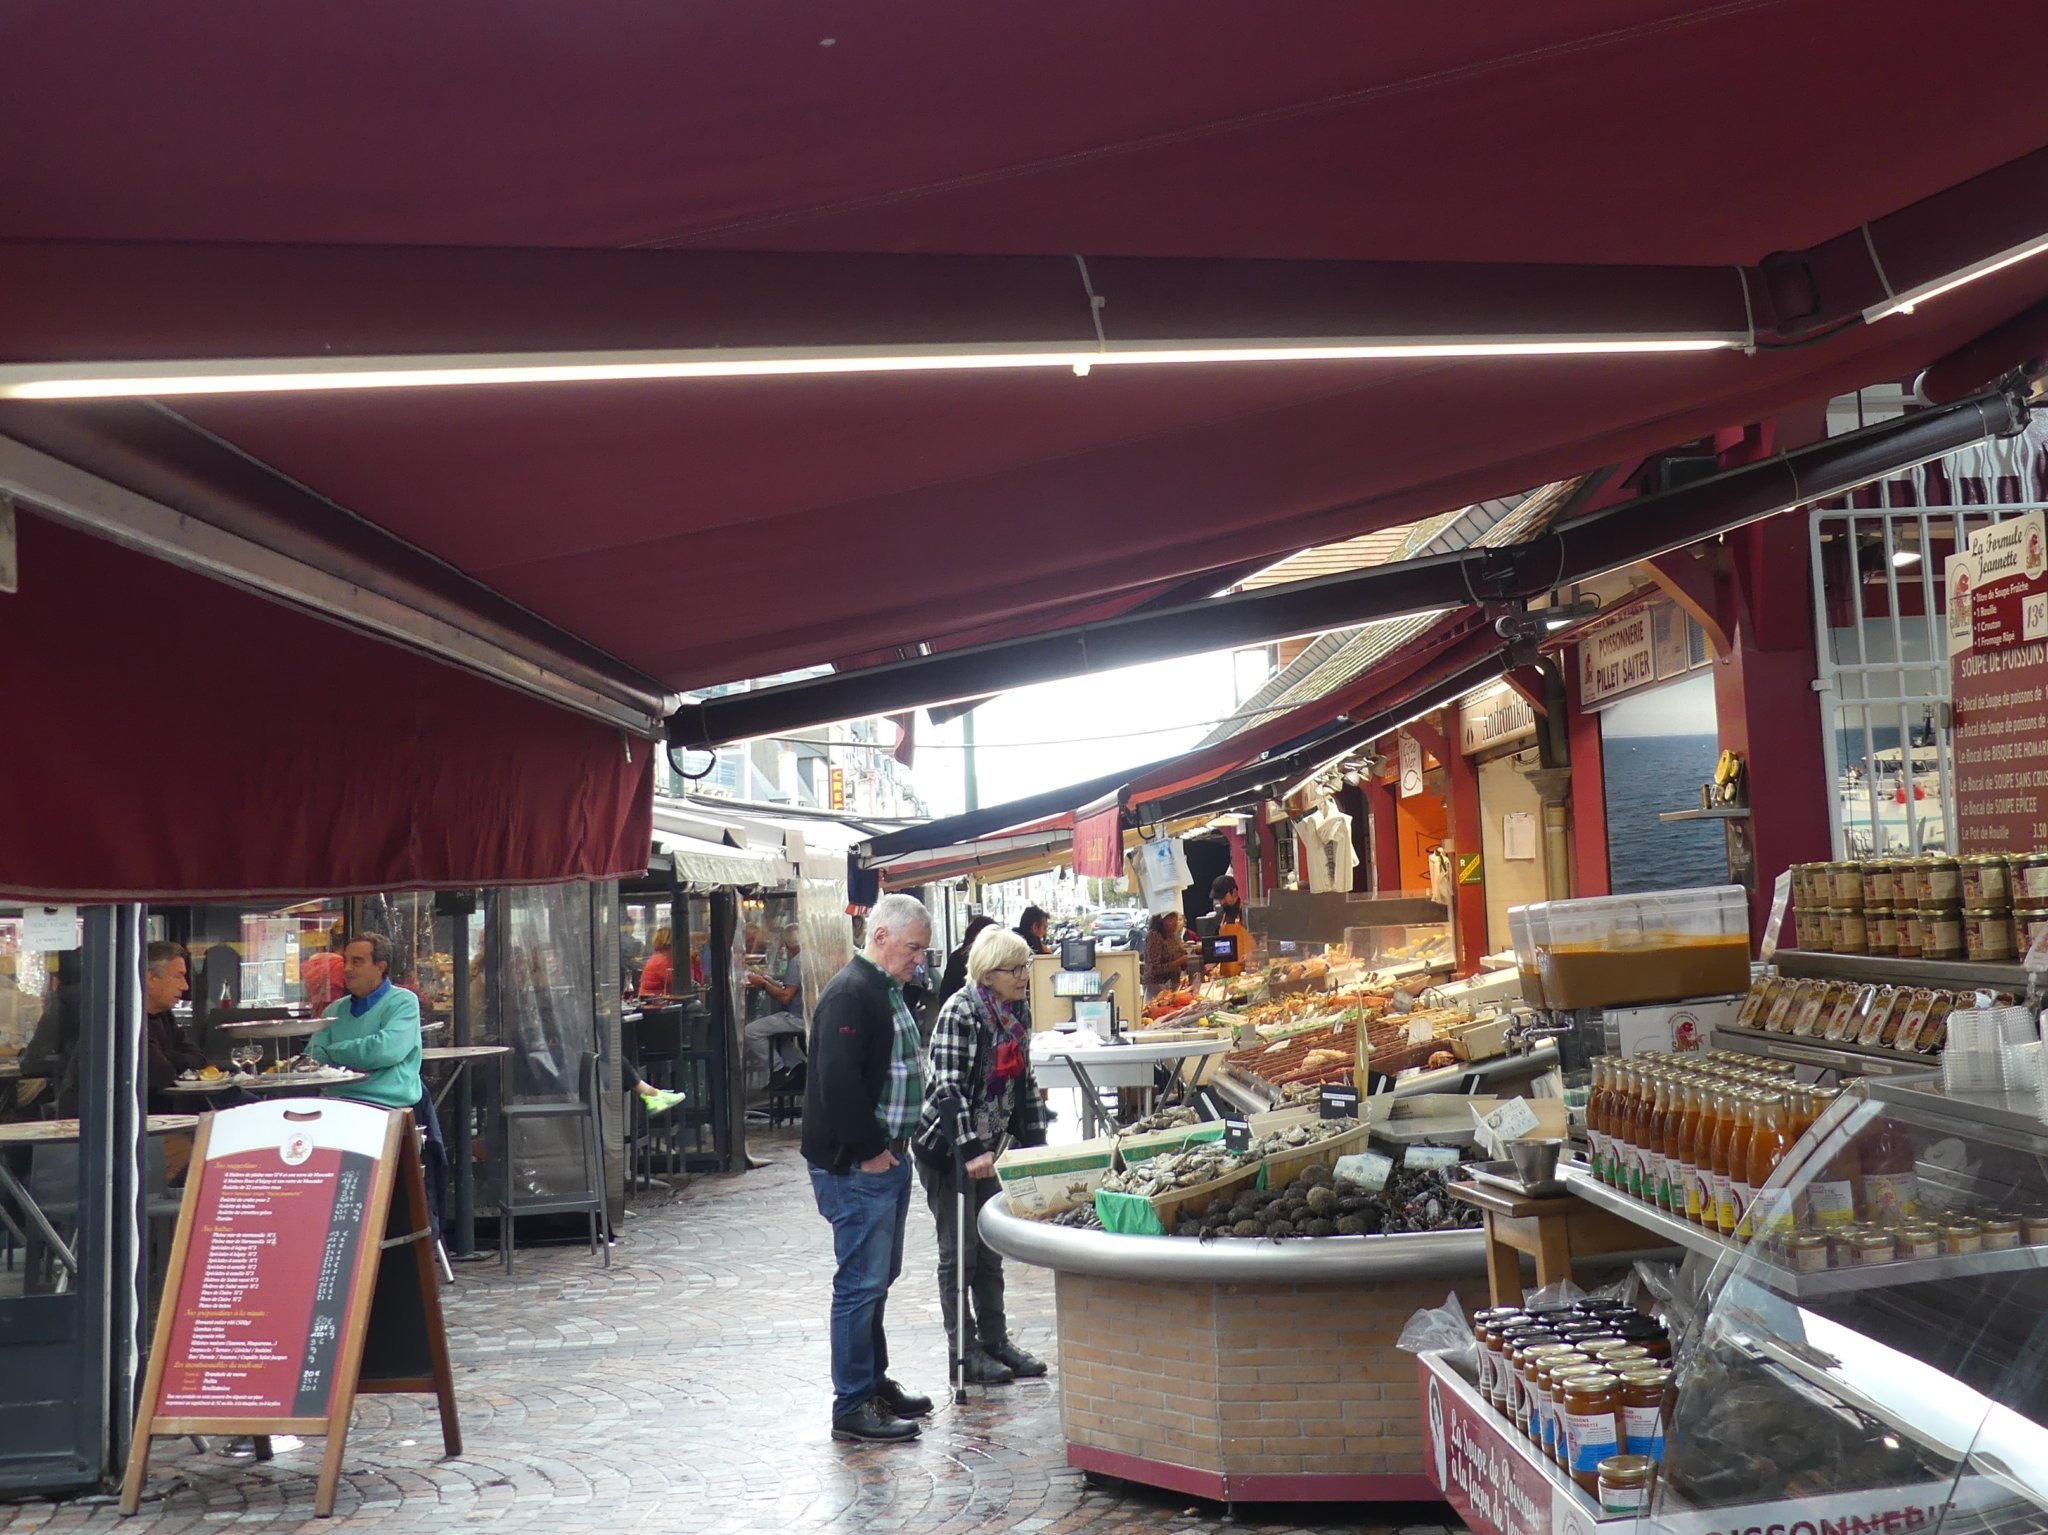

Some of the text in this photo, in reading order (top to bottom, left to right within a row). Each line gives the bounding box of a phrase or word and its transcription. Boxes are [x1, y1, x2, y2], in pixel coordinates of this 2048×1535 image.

[1972, 538, 1983, 557] La
[1978, 551, 2017, 581] Jeannette
[1599, 620, 1644, 659] POISSONNERIE
[1597, 650, 1651, 693] PILLET SAITER
[1961, 654, 1988, 678] SOUPE
[1989, 652, 2000, 673] DE
[2002, 644, 2044, 670] POISSONS
[1992, 743, 2013, 762] BISQUE
[2014, 742, 2023, 758] DE
[1994, 772, 2014, 789] SOUPE
[2015, 771, 2031, 788] SANS
[1995, 798, 2015, 814] SOUPE
[1450, 1408, 1540, 1531] La Soupe de Poissons
[1458, 1451, 1468, 1492] la
[1468, 1462, 1491, 1519] façon
[1493, 1489, 1504, 1532] de
